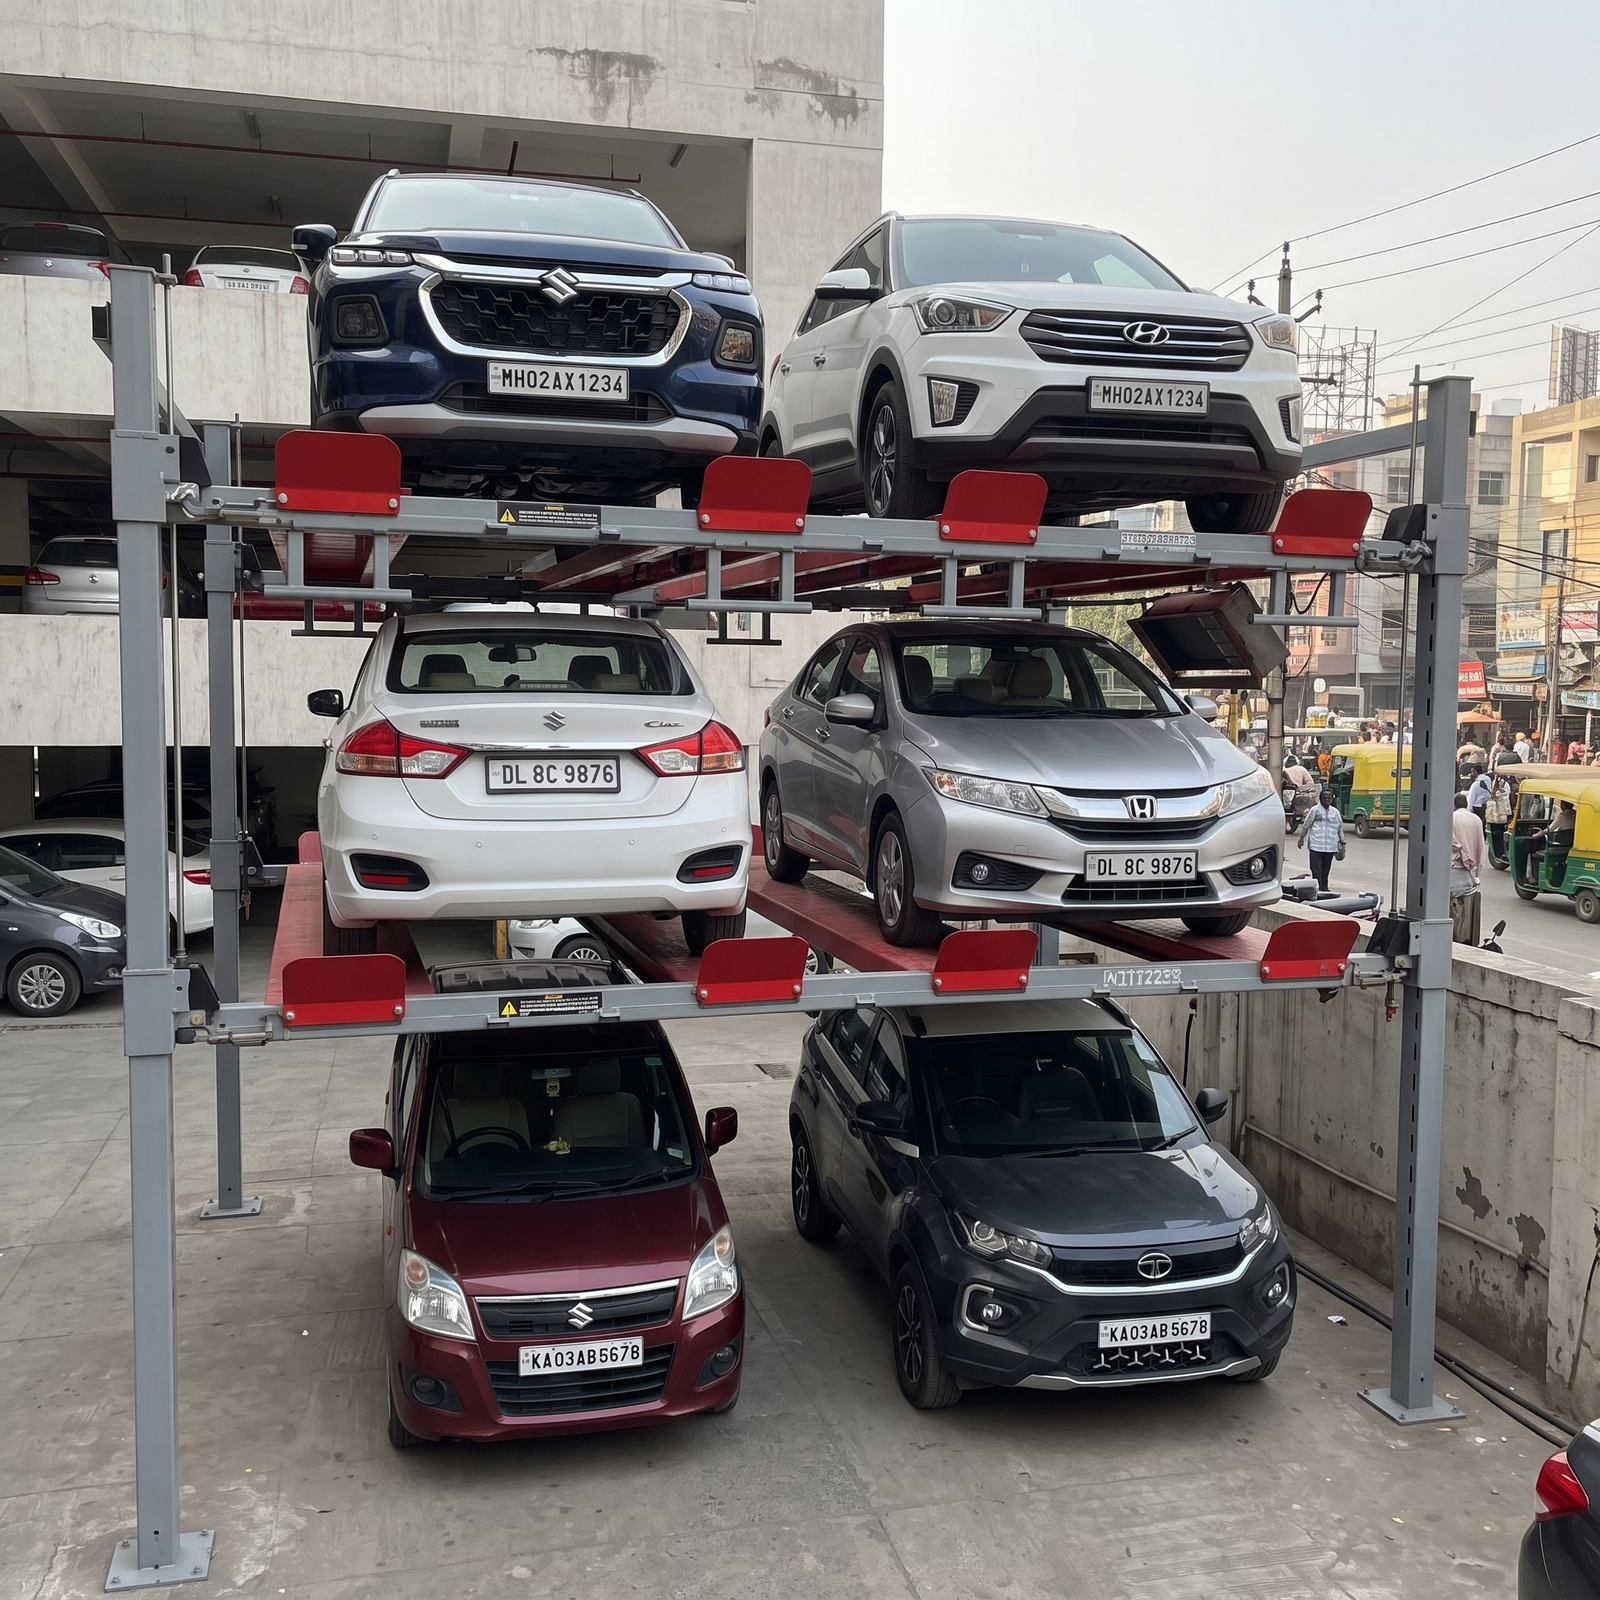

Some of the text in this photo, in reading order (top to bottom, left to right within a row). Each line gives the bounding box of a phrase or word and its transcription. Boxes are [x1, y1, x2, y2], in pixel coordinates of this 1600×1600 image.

[502, 368, 623, 394] MH02AX1234
[1102, 385, 1204, 408] MH02AX1234
[502, 764, 614, 784] DL 8C 9876
[1097, 858, 1118, 876] DL
[1124, 858, 1145, 876] 8C
[1151, 857, 1193, 875] 9876
[531, 1344, 640, 1370] KA03AB5678
